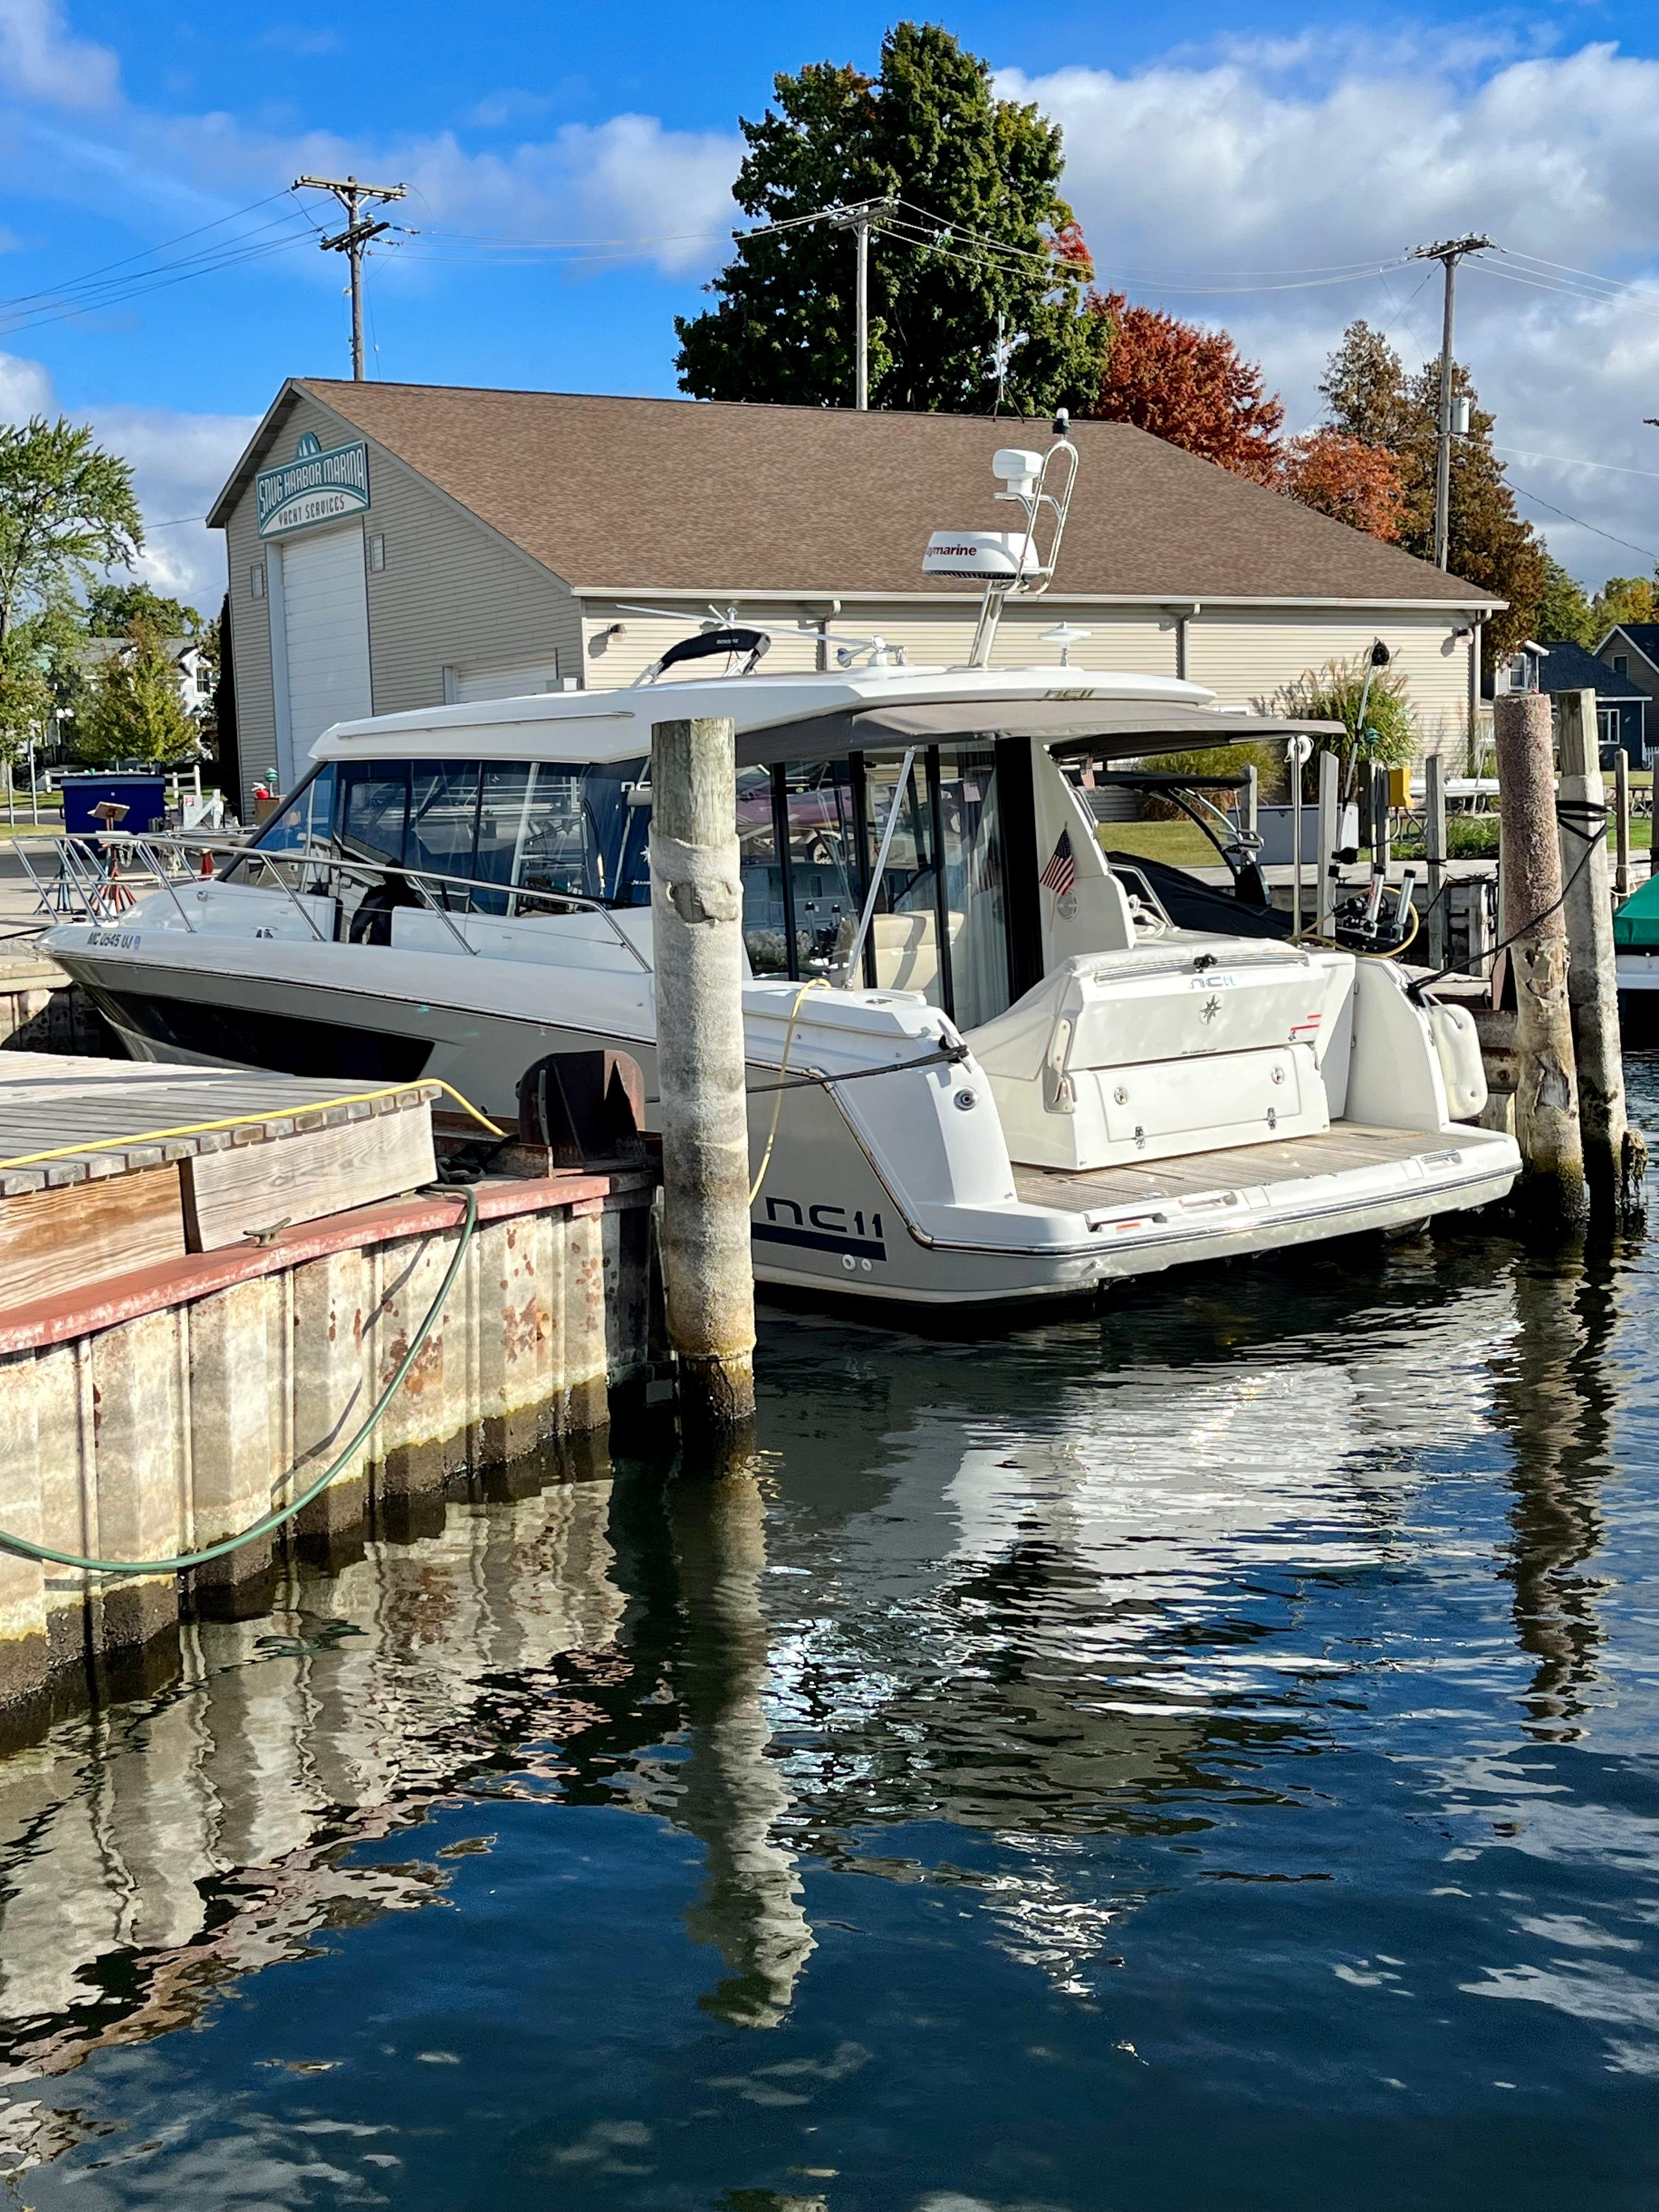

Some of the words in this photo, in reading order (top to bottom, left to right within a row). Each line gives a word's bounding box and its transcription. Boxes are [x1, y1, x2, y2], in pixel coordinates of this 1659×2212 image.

[259, 474, 283, 520] SNUG
[284, 462, 321, 497] HARBOR
[324, 448, 365, 490] MARINA
[278, 506, 302, 526] YACHT
[306, 494, 345, 520] SERVICES
[87, 932, 101, 945] MC
[121, 934, 133, 949] UJ
